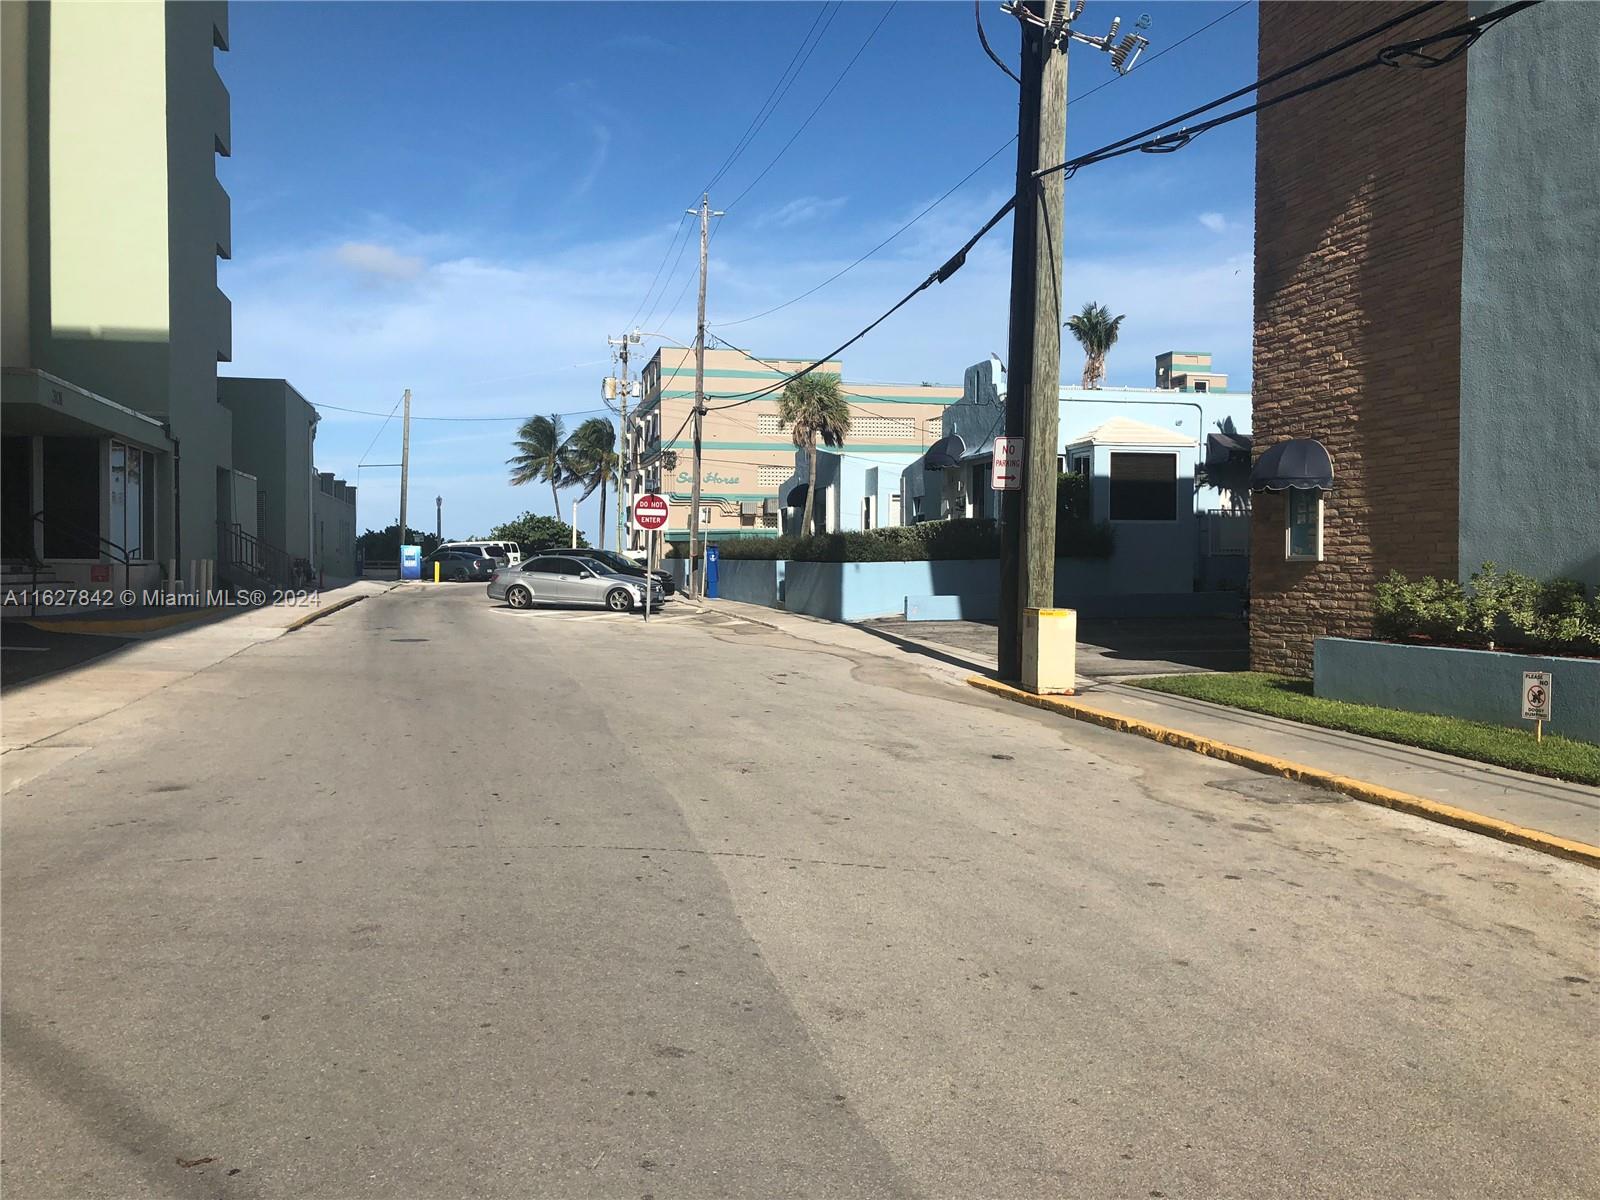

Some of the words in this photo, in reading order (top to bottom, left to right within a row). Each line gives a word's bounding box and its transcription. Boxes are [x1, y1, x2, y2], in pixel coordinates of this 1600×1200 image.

[1002, 445, 1015, 455] NO
[995, 459, 1021, 468] PARKING
[676, 471, 694, 484] Se
[703, 471, 740, 484] Horse
[650, 501, 663, 509] NOT
[641, 516, 661, 524] ENTER
